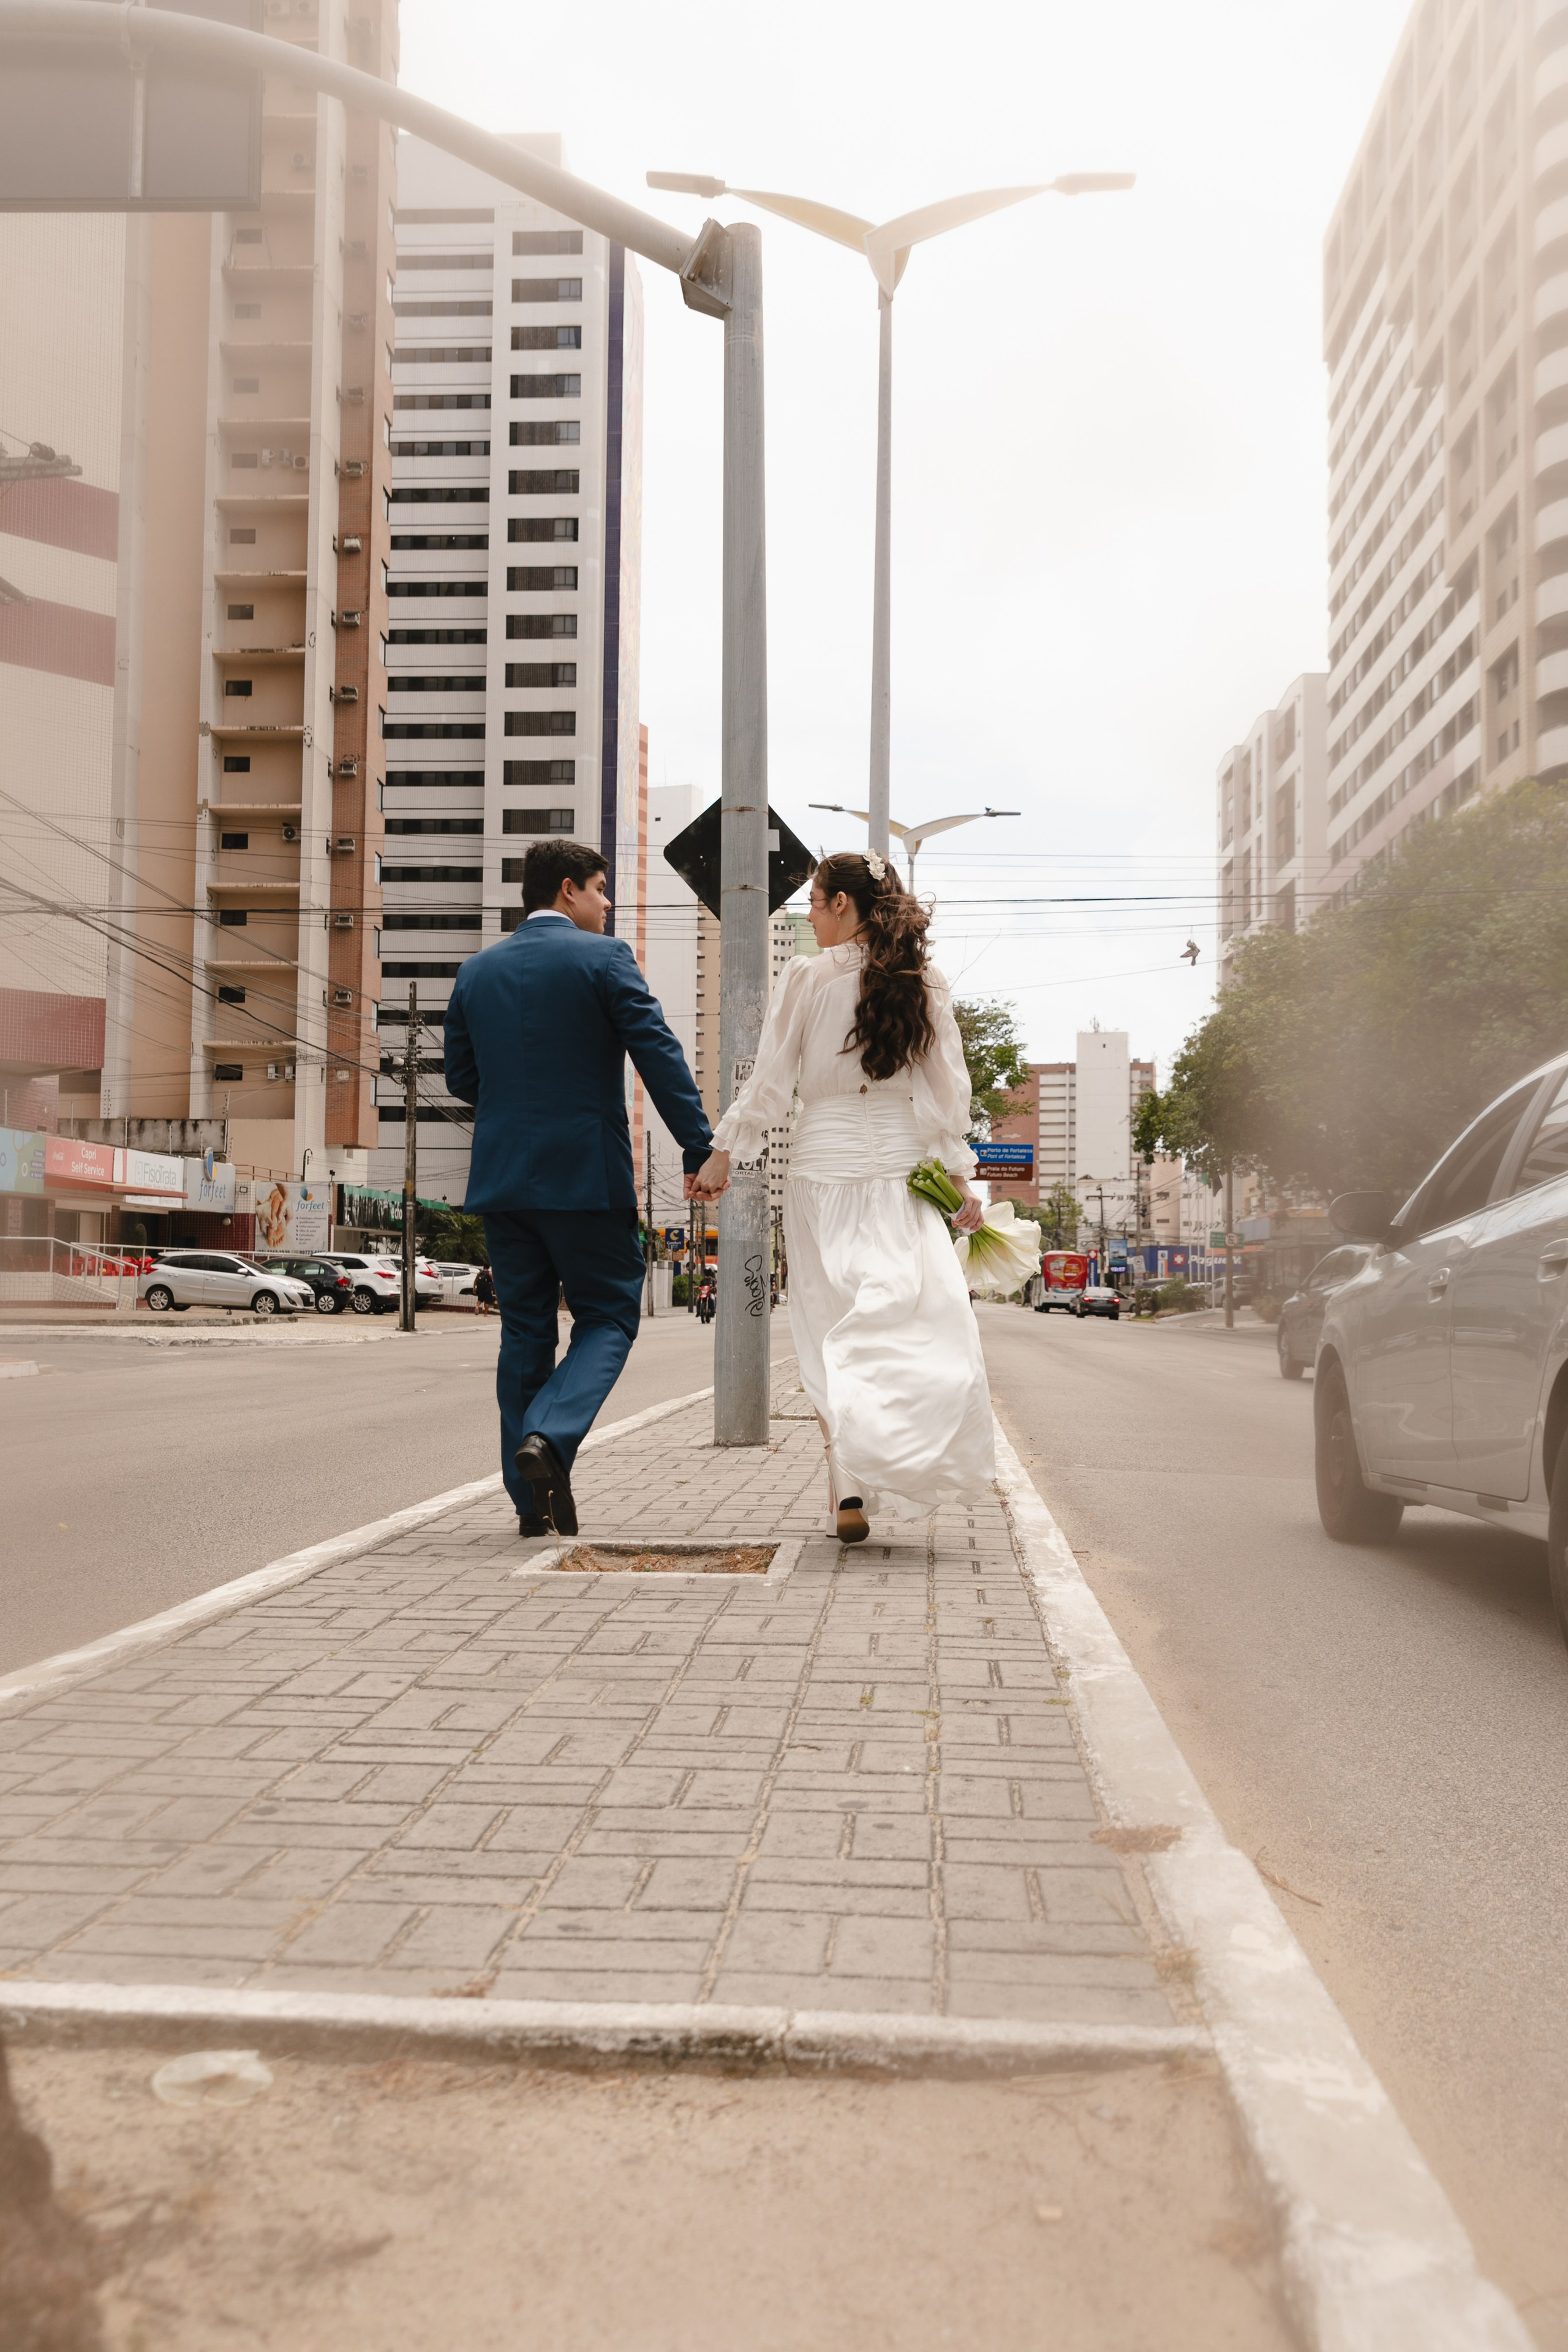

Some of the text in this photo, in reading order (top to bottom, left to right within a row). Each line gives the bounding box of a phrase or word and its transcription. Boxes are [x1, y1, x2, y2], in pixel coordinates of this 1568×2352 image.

[81, 1147, 96, 1161] Capri
[71, 1161, 105, 1177] Self Service
[143, 1163, 176, 1185] FisioTrata
[198, 1177, 227, 1202] forfeet
[295, 1200, 325, 1212] forfeet
